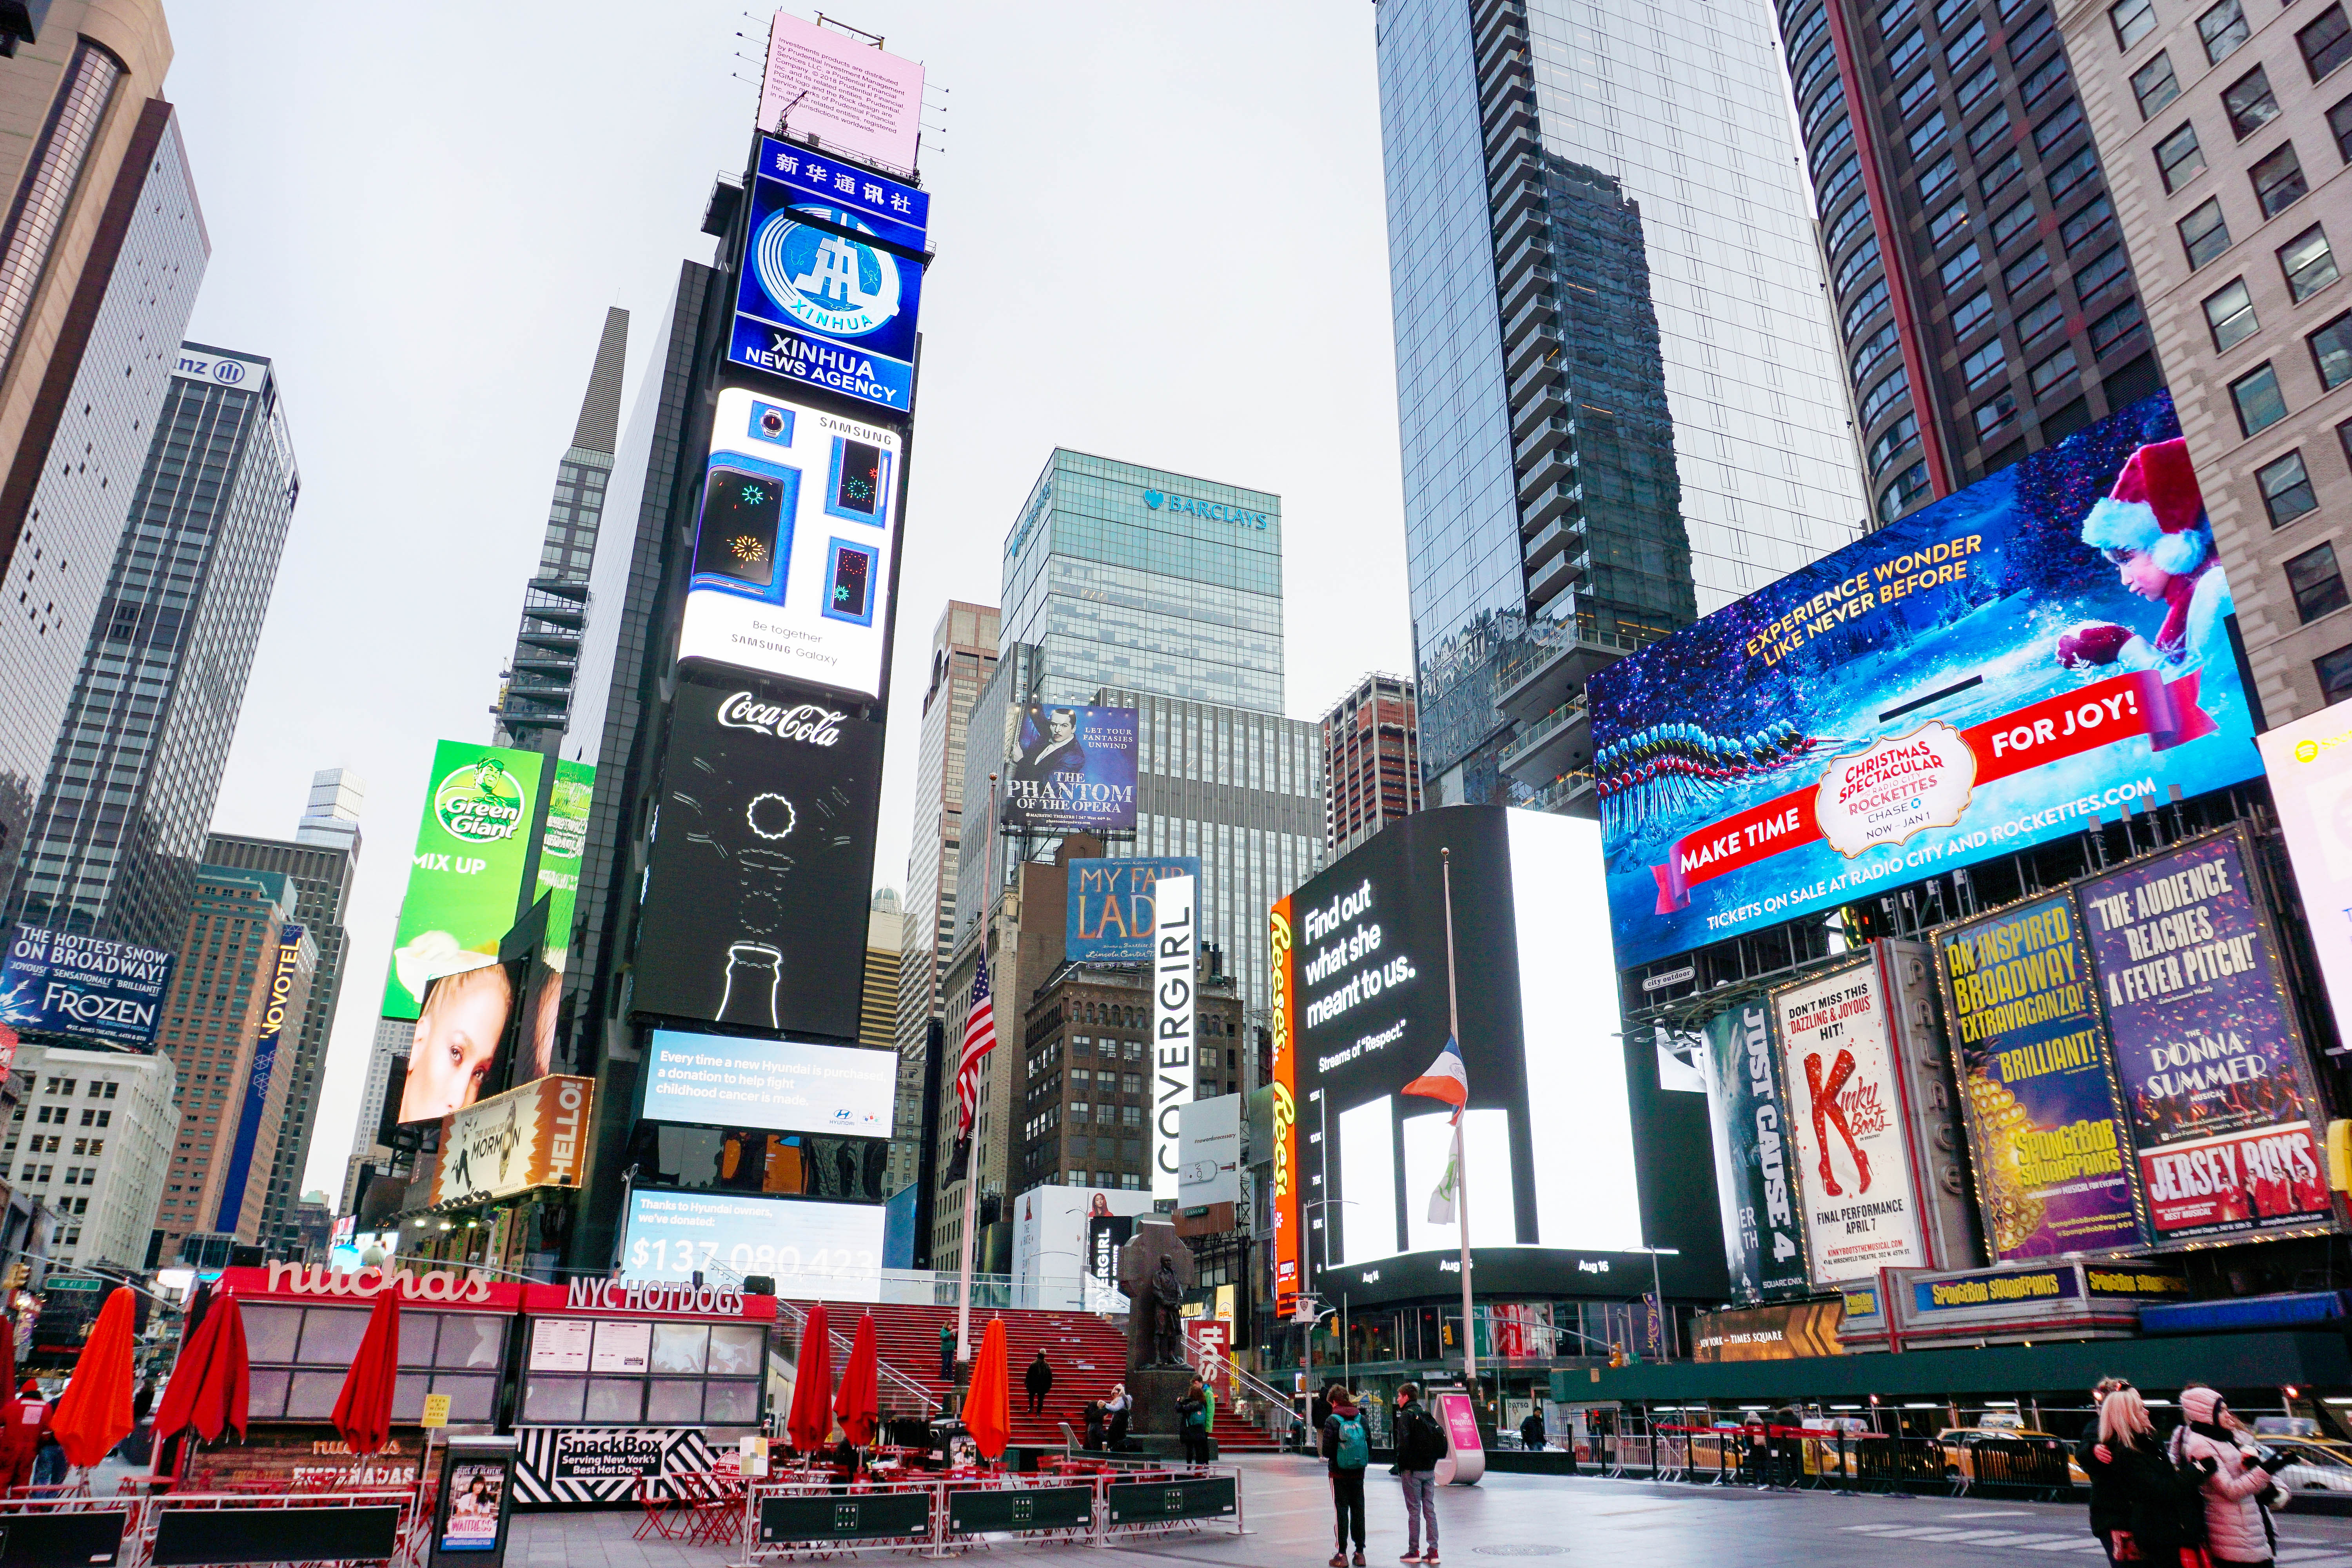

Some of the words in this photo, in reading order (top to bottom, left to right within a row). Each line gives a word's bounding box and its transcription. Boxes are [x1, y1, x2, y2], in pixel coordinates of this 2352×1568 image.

[779, 37, 820, 56] Investments
[822, 53, 850, 68] products
[865, 69, 898, 86] distributed
[788, 48, 822, 64] Prudential
[824, 62, 860, 79] Investment
[863, 76, 904, 96] Management
[776, 153, 911, 214] 新华通讯社
[791, 299, 873, 330] XINHUA
[745, 347, 807, 376] NEWS
[811, 367, 897, 402] AGENCY
[771, 333, 875, 380] XINHUA
[820, 416, 892, 445] SAMSUNG
[1170, 495, 1268, 529] BARCLAYS
[1746, 572, 1870, 657] EXPERIENCE
[1873, 534, 1982, 583] WONDER
[1763, 633, 1804, 667] LIKE
[1807, 592, 1875, 639] NEVER
[1880, 560, 1967, 604] BEFORE
[731, 633, 791, 654] SAMSUNG
[796, 648, 837, 666] Galaxy
[753, 620, 768, 631] Be
[771, 624, 822, 643] together
[717, 691, 848, 747] Coca-Cola
[1991, 719, 2056, 758] FOR
[2062, 690, 2138, 735] JOY!
[1054, 772, 1085, 783] THE
[1839, 755, 1945, 804] SPECTACULAR
[1846, 741, 1930, 783] CHRISTMAS
[446, 796, 518, 821] Green
[1005, 780, 1133, 803] PHANTOM
[1017, 799, 1036, 808] OF
[1040, 799, 1070, 810] THE
[1073, 801, 1121, 813] OPERA
[1849, 775, 1937, 815] ROCKETTES
[451, 814, 518, 839] Giant
[1868, 803, 1909, 823] CHASE
[1680, 829, 1741, 875] MAKE
[1744, 807, 1800, 847] TIME
[1707, 904, 1762, 931] TICKETS
[1764, 894, 1788, 913] ON
[1790, 881, 1826, 905] SALE
[1829, 875, 1847, 892] AT
[1850, 857, 1903, 886] RADIO
[1906, 843, 1943, 869] CITY
[1947, 831, 1988, 857] AND
[1991, 777, 2157, 842] ROCKETTES.COM
[412, 853, 450, 872] MIX
[455, 856, 486, 875] UP
[2136, 859, 2232, 920] AUDIENCE
[1304, 895, 1339, 946] Find
[1341, 879, 1372, 922] out
[15, 940, 46, 960] ON
[54, 933, 122, 956] HOTTEST
[123, 946, 168, 964] SNOW
[1977, 906, 2070, 965] INSPIRED
[2125, 906, 2214, 962] REACHES
[1305, 937, 1348, 986] what
[1349, 924, 1381, 962] she
[260, 938, 301, 1039] NOVOTEL
[1271, 910, 1291, 1050] Reese's
[1307, 975, 1360, 1029] meant
[1361, 969, 1381, 1001] to
[1384, 956, 1416, 989] us.
[1648, 978, 1661, 987] city
[1662, 971, 1691, 984] outdoor
[1954, 943, 2076, 1014] BROADWAY
[2108, 973, 2124, 1007] A
[2123, 955, 2184, 1002] FEVER
[42, 982, 155, 1026] FROZEN
[1789, 1001, 1816, 1020] DON'T
[1818, 993, 1843, 1009] MISS
[1844, 984, 1867, 998] THIS
[1829, 1009, 1837, 1020] &
[1158, 907, 1190, 1174] COVERGIRL
[1820, 1023, 1844, 1042] HIT!
[661, 1051, 694, 1066] Every
[696, 1054, 723, 1067] time
[724, 1059, 732, 1068] a
[734, 1060, 760, 1070] new
[762, 1061, 810, 1074] Hyundai
[813, 1065, 821, 1075] is
[824, 1067, 887, 1083] purchased,
[1319, 1049, 1351, 1073] Streams
[1351, 1042, 1361, 1059] of
[1744, 1007, 1775, 1099] JUST
[2151, 1031, 2246, 1072] DONNA
[2147, 1055, 2268, 1099] SUMMER
[484, 1125, 496, 1136] BOOK
[549, 1081, 583, 1183] HELLO!
[1194, 1133, 1236, 1145] #nowordsnecessary
[1310, 1131, 1321, 1144] 100K
[1851, 1108, 1892, 1136] Boots
[1312, 1175, 1321, 1186] 75K
[1756, 1104, 1791, 1228] CAUSE
[2022, 1149, 2122, 1186] SQUAREPANTS
[2151, 1145, 2238, 1202] JERSEY
[2241, 1133, 2318, 1183] BOYS
[1313, 1218, 1323, 1229] 50K
[1817, 1210, 1840, 1225] FINAL
[1841, 1199, 1904, 1221] PERFORMANCE
[1846, 1220, 1870, 1235] APRIL
[1871, 1218, 1875, 1230] 7
[1773, 1231, 1796, 1263] 4
[268, 1254, 491, 1302] nuchas
[1579, 1260, 1597, 1274] Aug
[1598, 1261, 1609, 1272] 16
[568, 1277, 619, 1308] NYC
[625, 1279, 744, 1314] HOTDOGS
[1198, 1326, 1223, 1381] tkts
[1700, 1338, 1709, 1348] NEW
[1710, 1336, 1723, 1346] YORK
[1731, 1334, 1751, 1344] TIMES
[1753, 1331, 1782, 1343] SQUARE
[559, 1436, 664, 1453] SnackBox
[562, 1455, 601, 1466] Serving
[603, 1455, 626, 1465] New
[628, 1454, 655, 1464] York's
[573, 1466, 596, 1474] Best
[598, 1465, 617, 1474] Hot
[619, 1465, 643, 1476] Dogs
